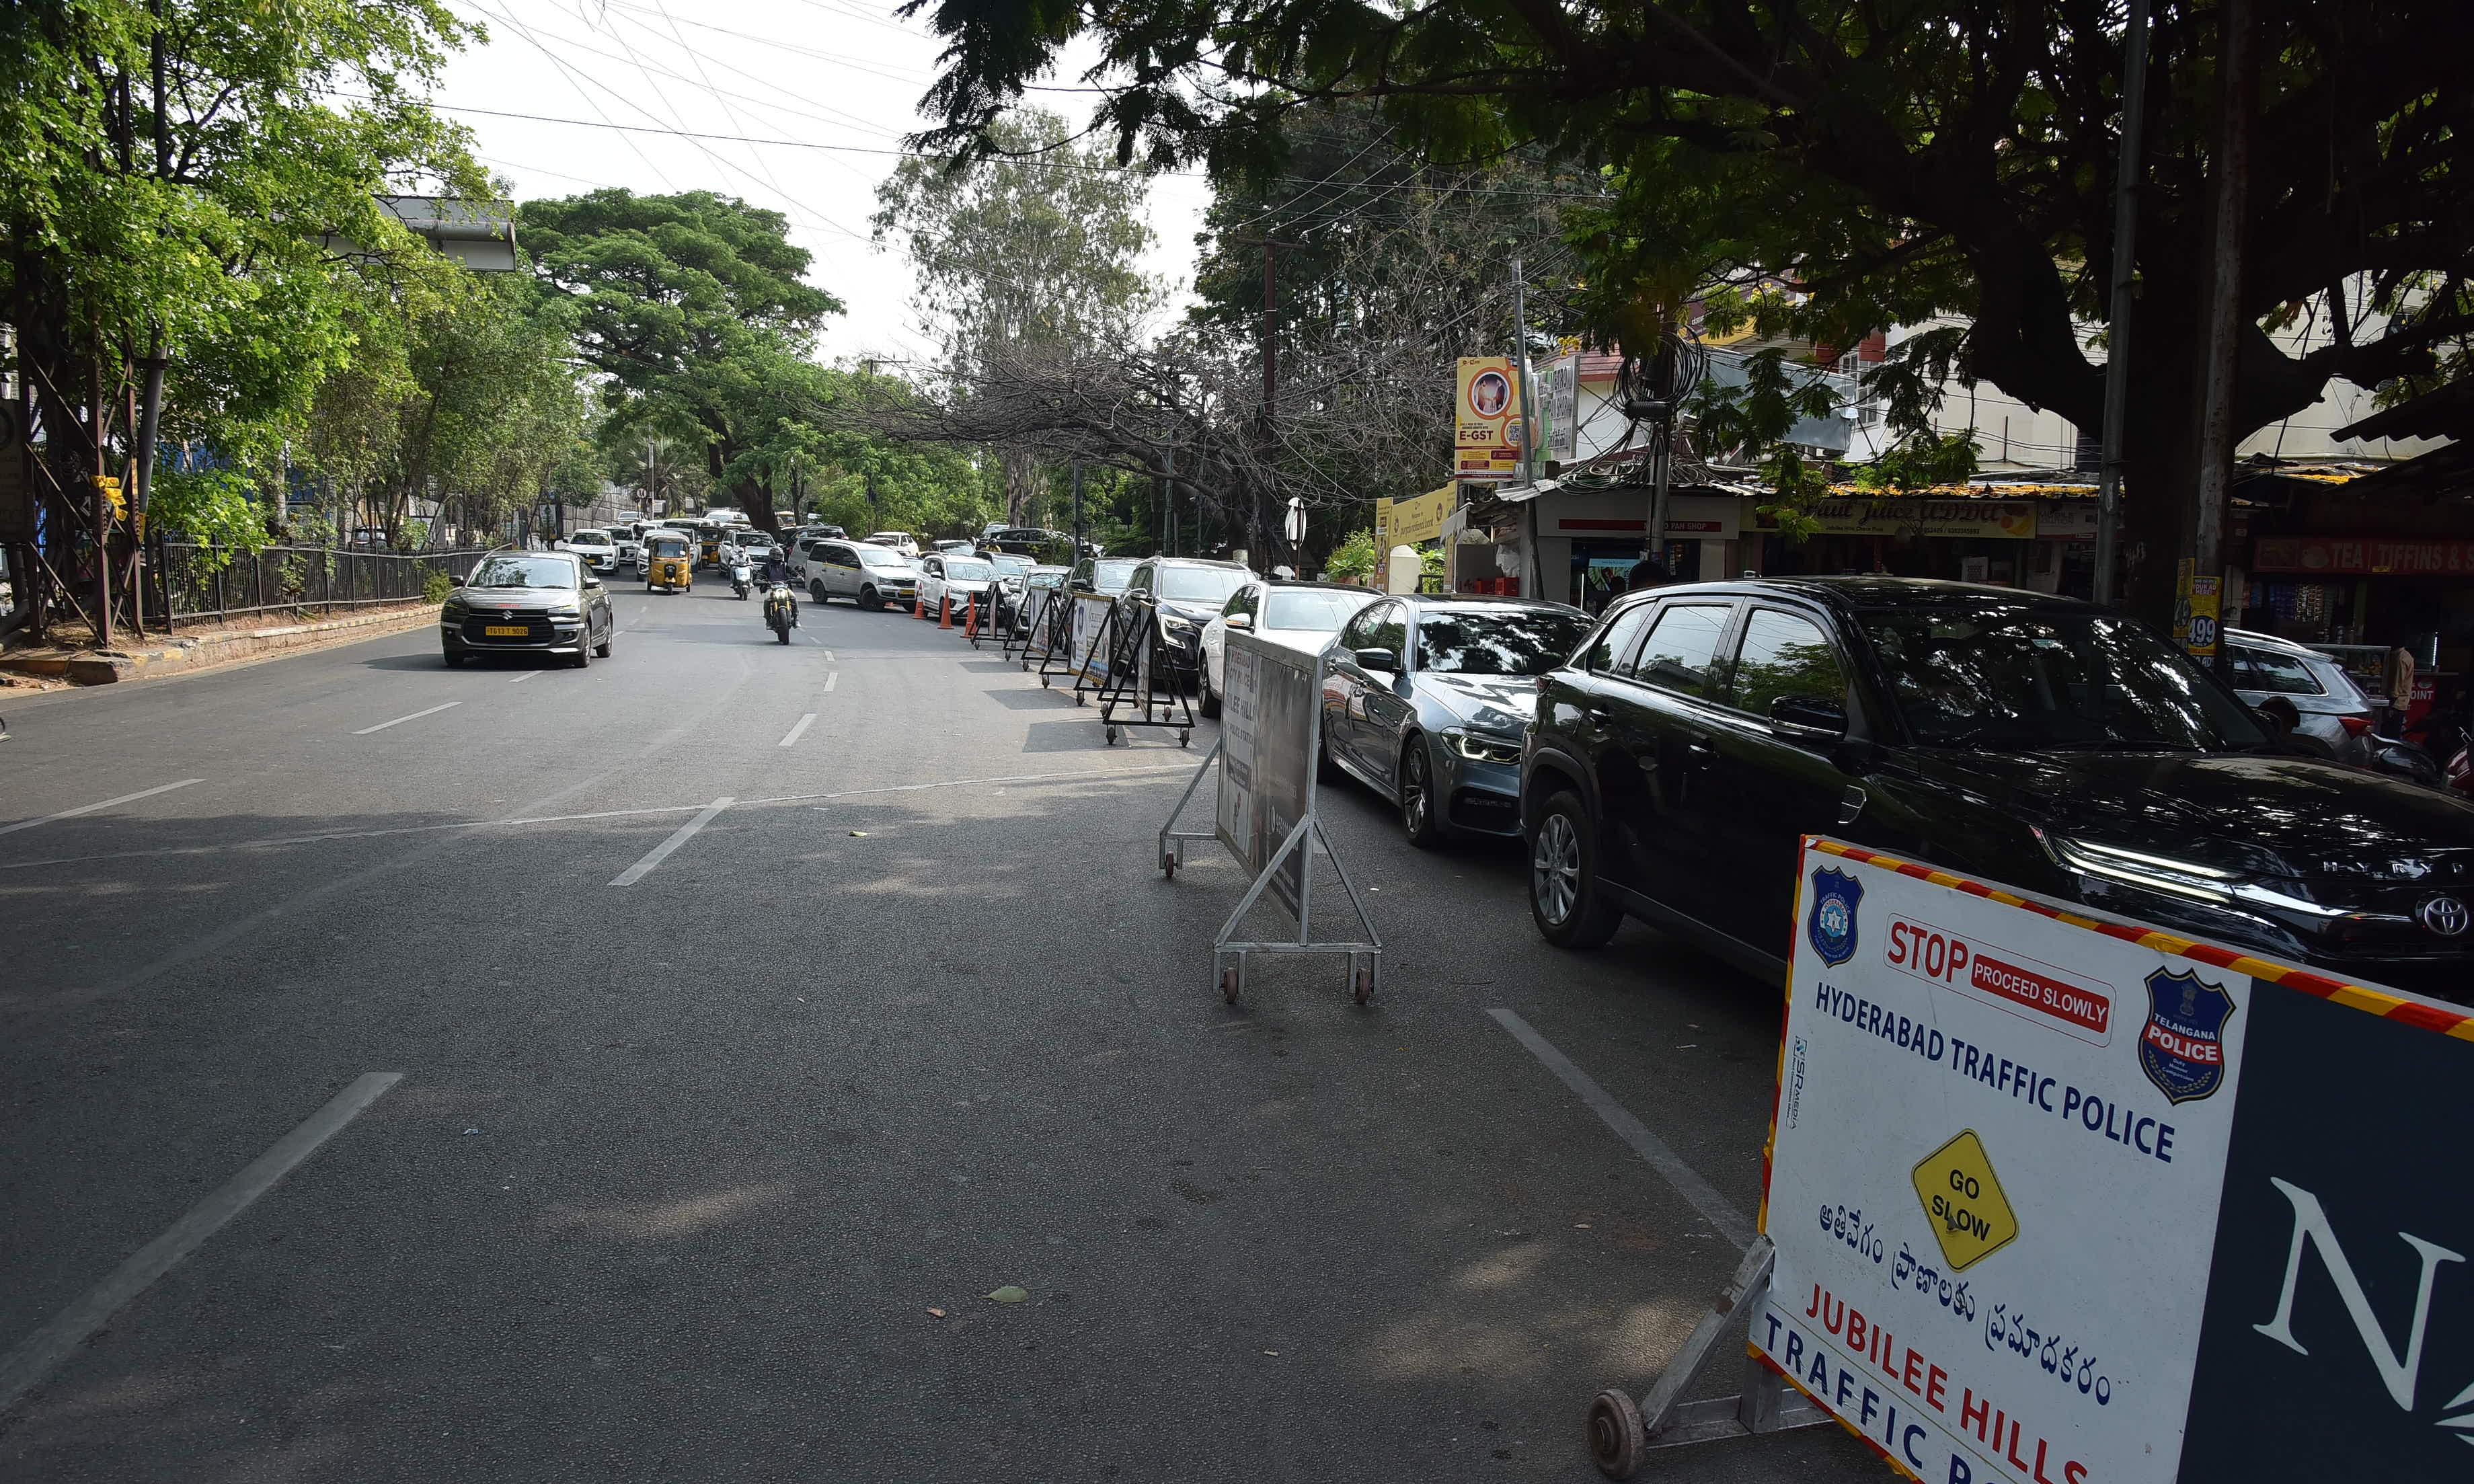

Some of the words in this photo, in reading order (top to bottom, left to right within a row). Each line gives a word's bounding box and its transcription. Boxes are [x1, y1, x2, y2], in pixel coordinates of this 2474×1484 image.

[1460, 430, 1493, 440] E-GST
[1687, 522, 1707, 531] SHOP
[1858, 501, 1915, 524] Juice
[2331, 543, 2363, 569] TEA
[2377, 543, 2443, 570] TIFFINS
[2448, 543, 2460, 570] &
[2188, 619, 2216, 643] 499
[2410, 690, 2434, 701] OINT
[1888, 921, 1969, 983] STOP
[1974, 963, 2040, 1000] PROCEED
[2042, 987, 2107, 1023] SLOWLY
[2154, 1012, 2216, 1041] TELANGANA
[2148, 1025, 2218, 1062] POLICE
[1816, 982, 1942, 1062] HYDERABAD
[1951, 1038, 2056, 1113] TRAFFIC
[2062, 1085, 2175, 1164] POLICE
[1949, 1169, 1980, 1200] GO
[1932, 1194, 1991, 1242] SLOW
[1820, 1204, 1883, 1264] అతివేగం
[1891, 1242, 1976, 1323] ప్రాణాలకు
[1984, 1302, 2111, 1406] ప్రమాదకరం
[1806, 1283, 1946, 1415] JUBILEE
[1765, 1313, 1927, 1471] TRAFFIC
